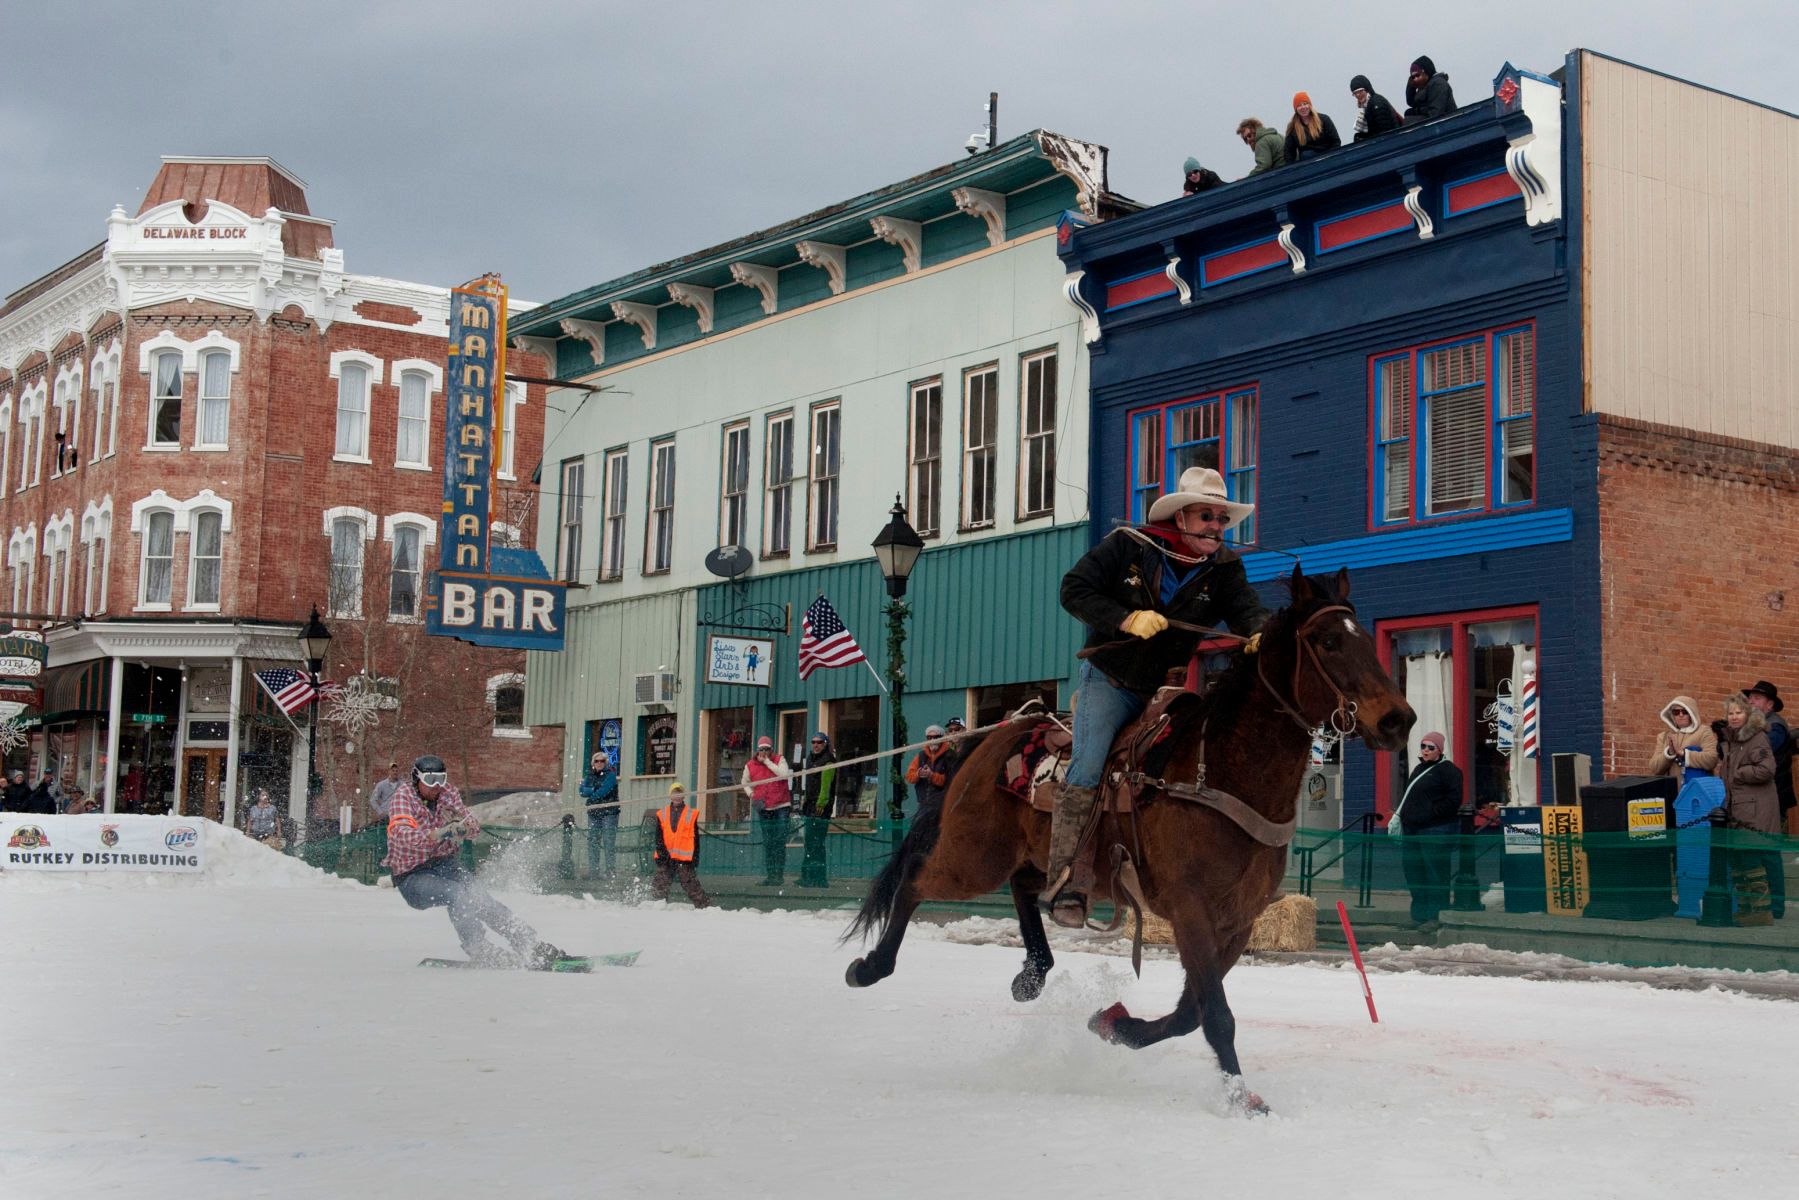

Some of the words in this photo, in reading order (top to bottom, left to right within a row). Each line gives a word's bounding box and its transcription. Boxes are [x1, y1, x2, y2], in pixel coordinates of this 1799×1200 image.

[143, 228, 205, 239] DELAWARE
[209, 228, 247, 239] BLOCK
[442, 582, 557, 631] BAR
[1631, 814, 1664, 826] SUNDAY
[10, 853, 74, 864] RUTKEY
[82, 853, 198, 867] DISTRIBUTING
